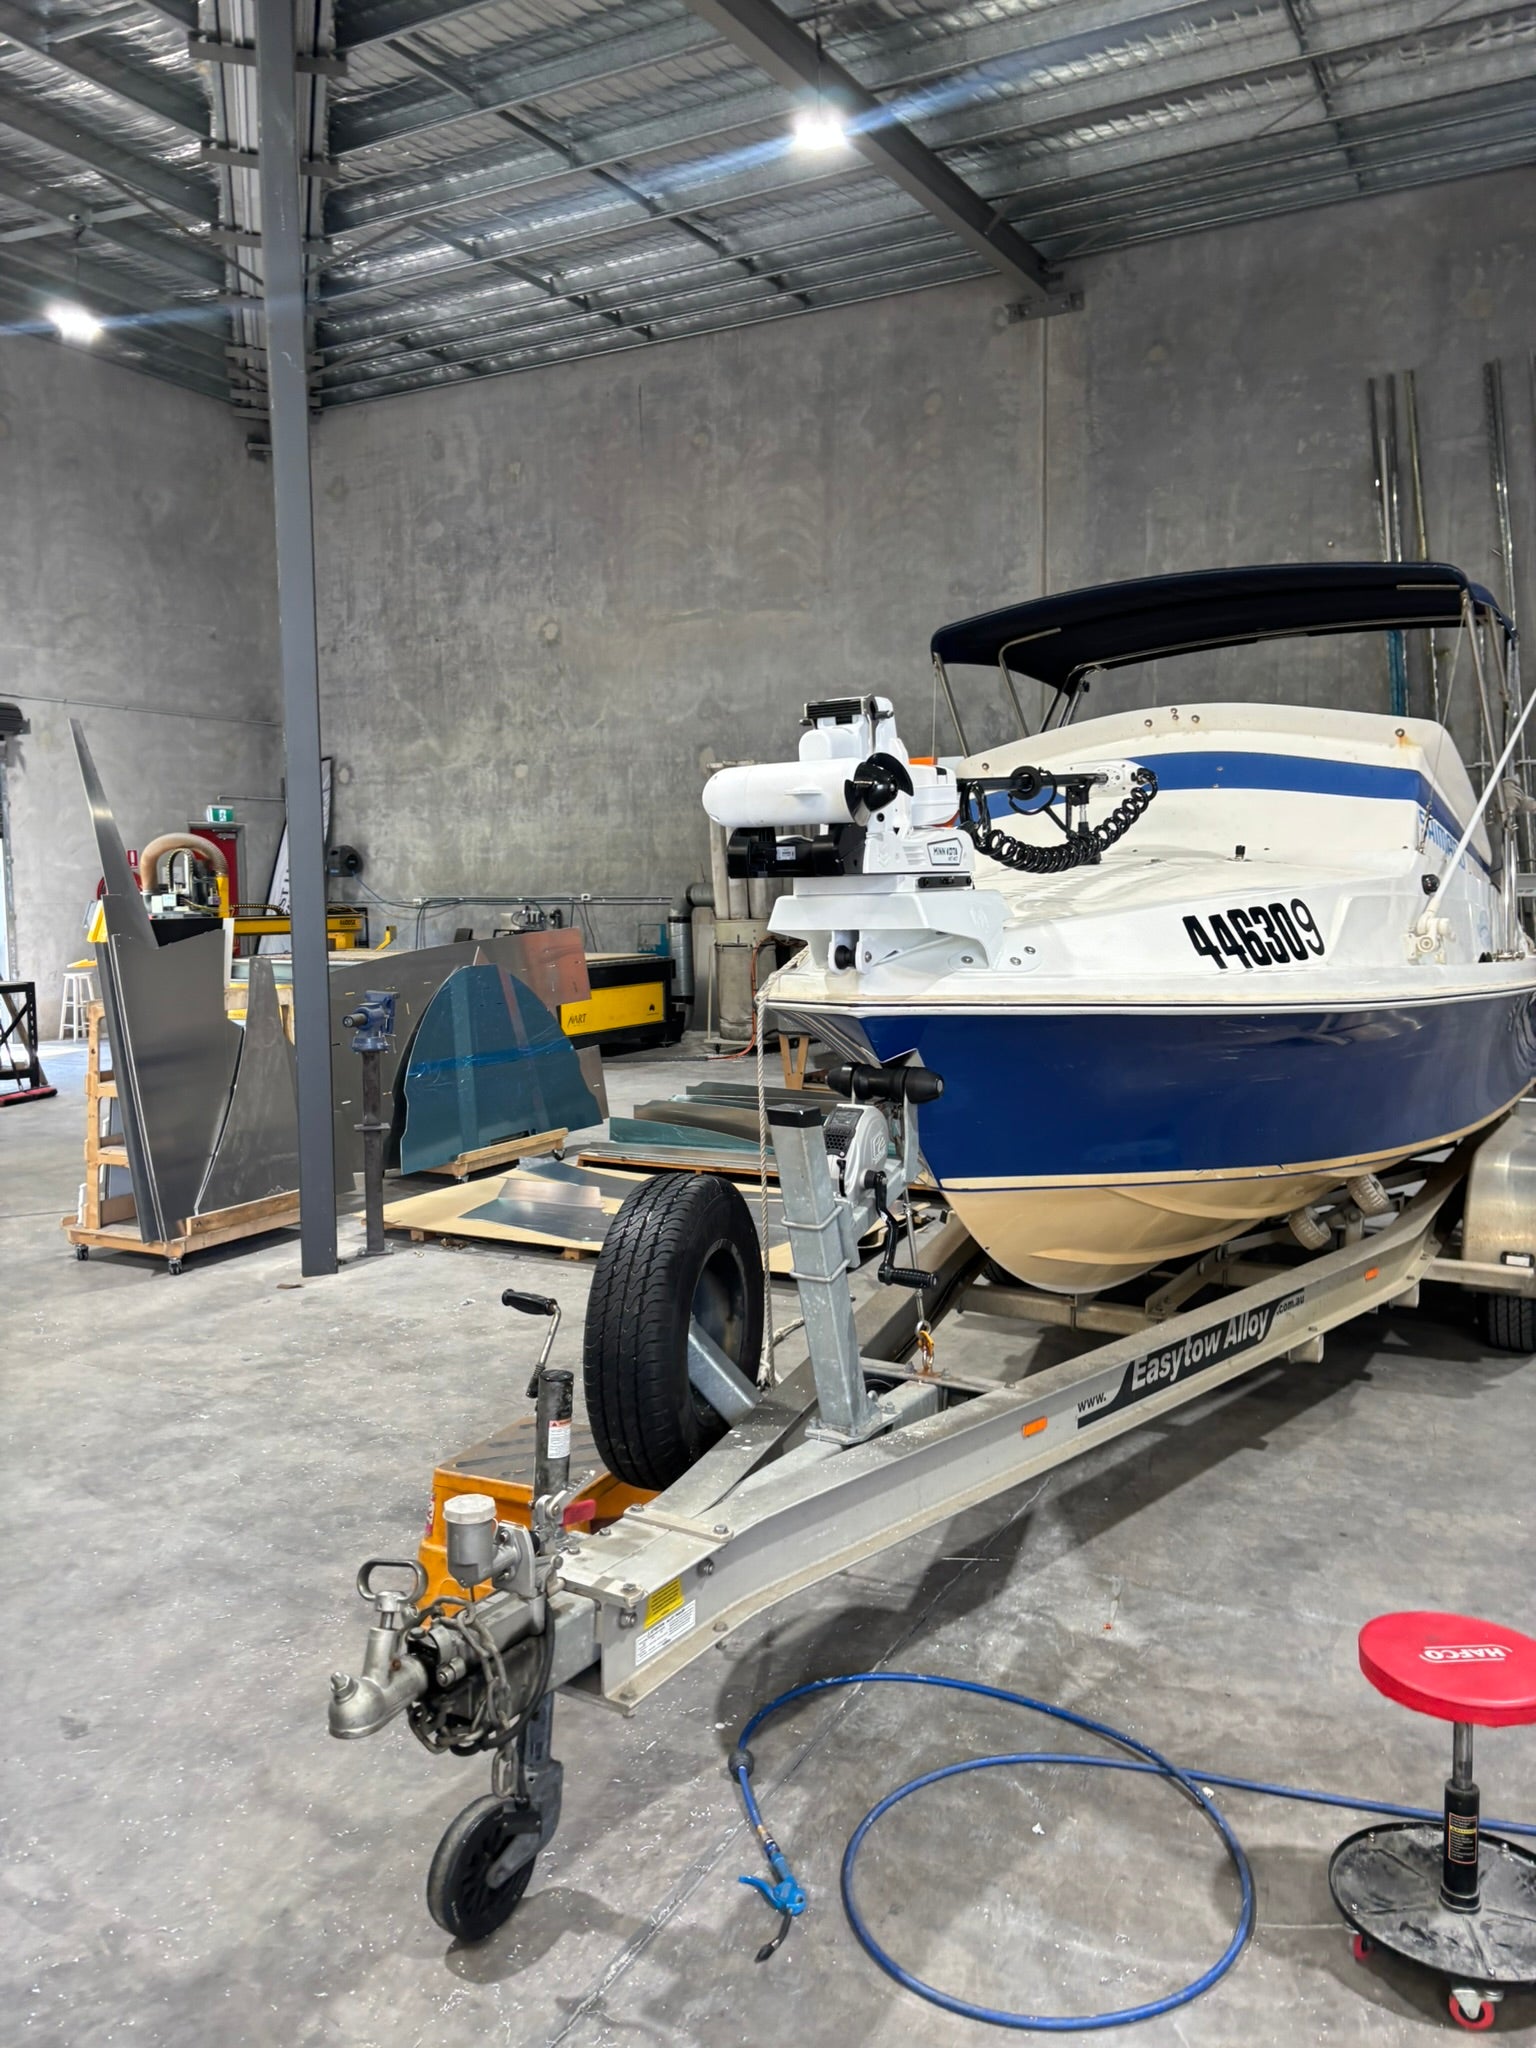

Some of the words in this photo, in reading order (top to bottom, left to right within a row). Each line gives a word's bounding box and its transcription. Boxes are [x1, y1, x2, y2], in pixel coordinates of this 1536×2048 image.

[1182, 898, 1325, 969] 446309
[1077, 1392, 1107, 1413] www.
[1131, 1326, 1223, 1392] Easytow
[1223, 1308, 1270, 1350] Alloy
[1276, 1296, 1305, 1316] .com.au
[1424, 1648, 1506, 1659] HAFCO
